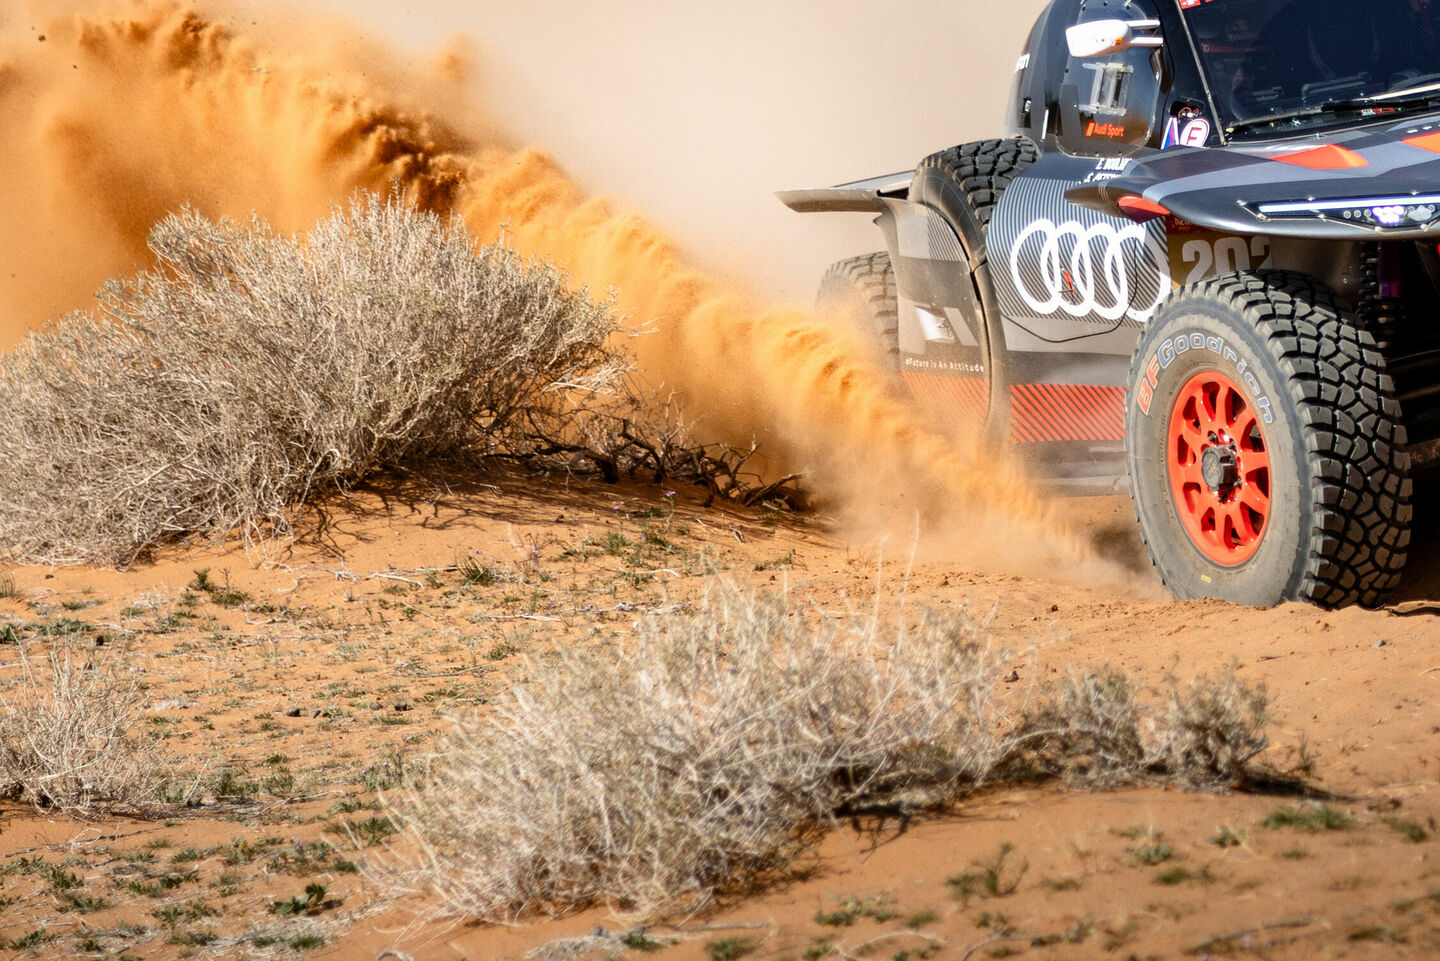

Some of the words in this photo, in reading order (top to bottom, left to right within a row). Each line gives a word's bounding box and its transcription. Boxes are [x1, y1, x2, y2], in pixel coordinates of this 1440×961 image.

[1093, 122, 1107, 136] Audi
[1107, 123, 1125, 139] Sport
[1137, 332, 1274, 424] BFGoodrich
